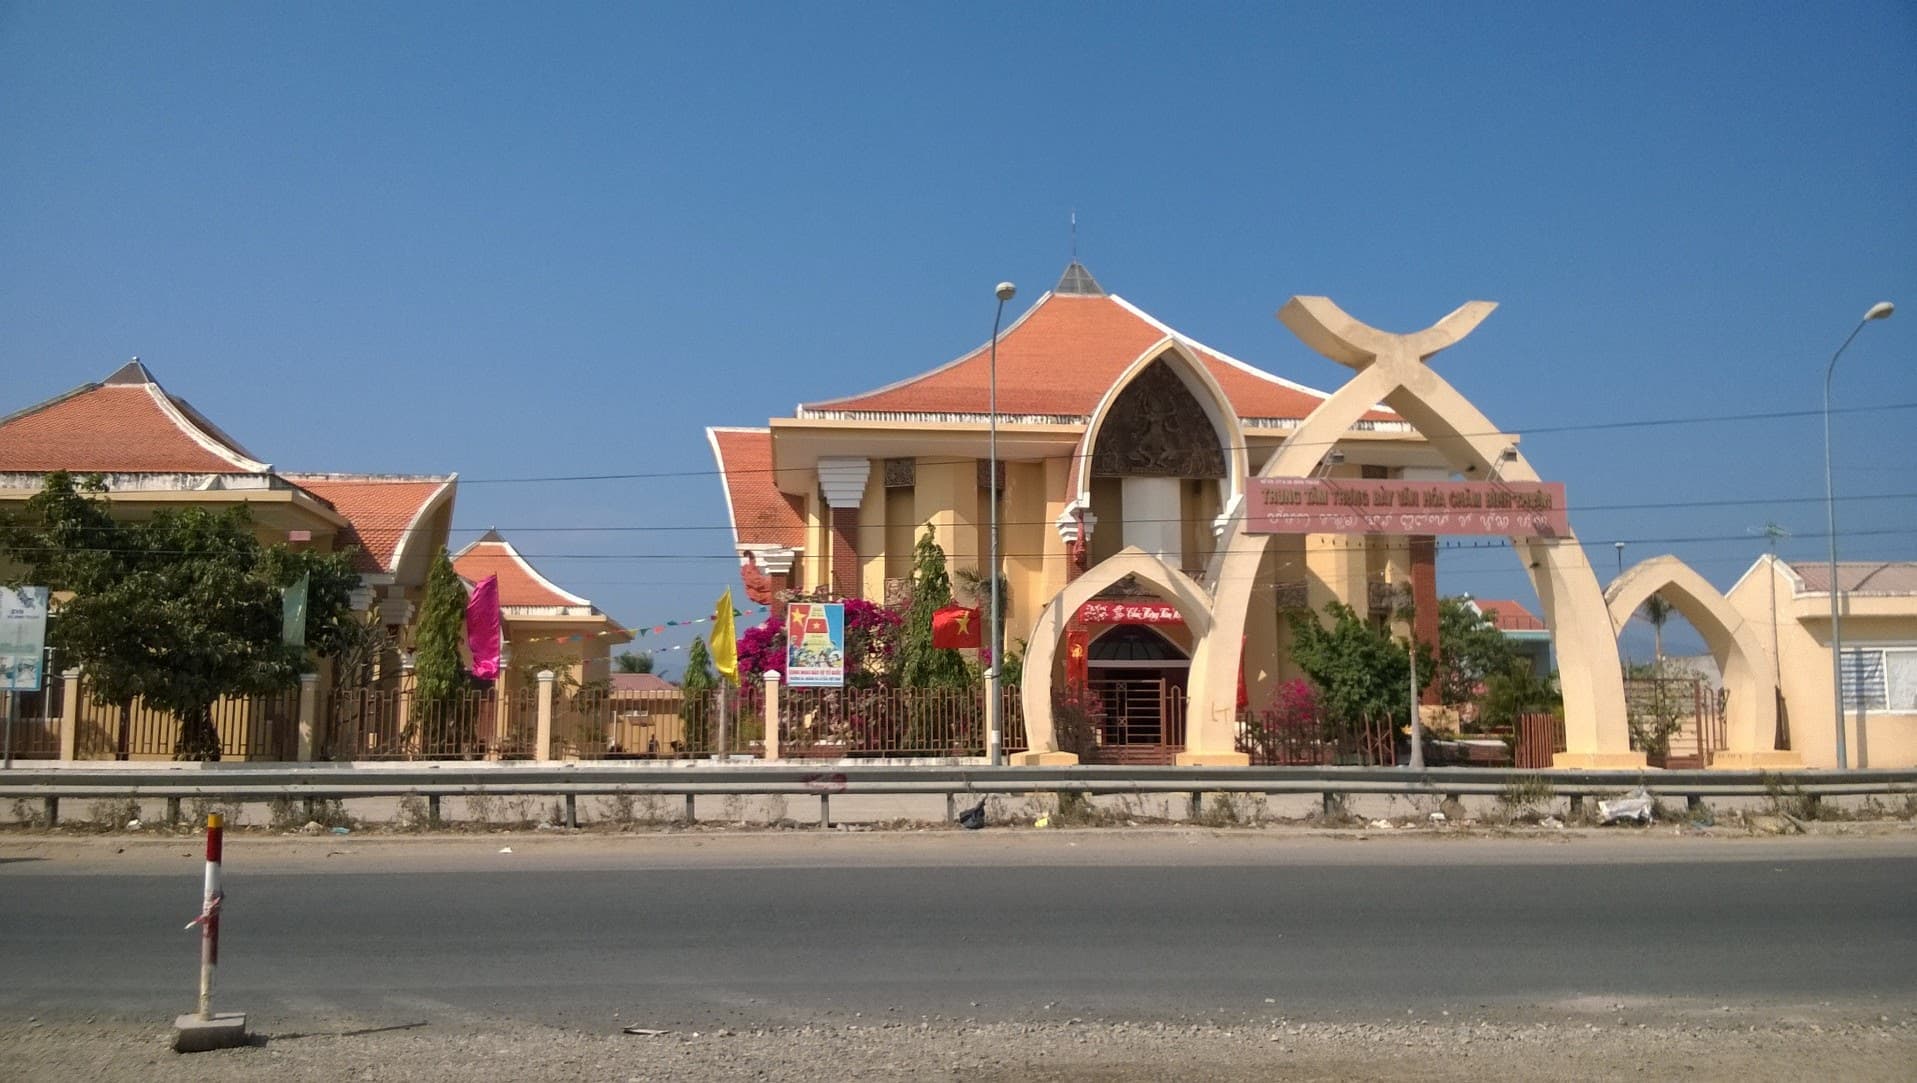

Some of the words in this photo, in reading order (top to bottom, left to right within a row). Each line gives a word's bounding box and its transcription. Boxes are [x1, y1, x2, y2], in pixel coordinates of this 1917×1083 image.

[1261, 488, 1301, 505] TRUNG
[1304, 487, 1328, 506] TÂM
[1373, 485, 1394, 506] BÀY
